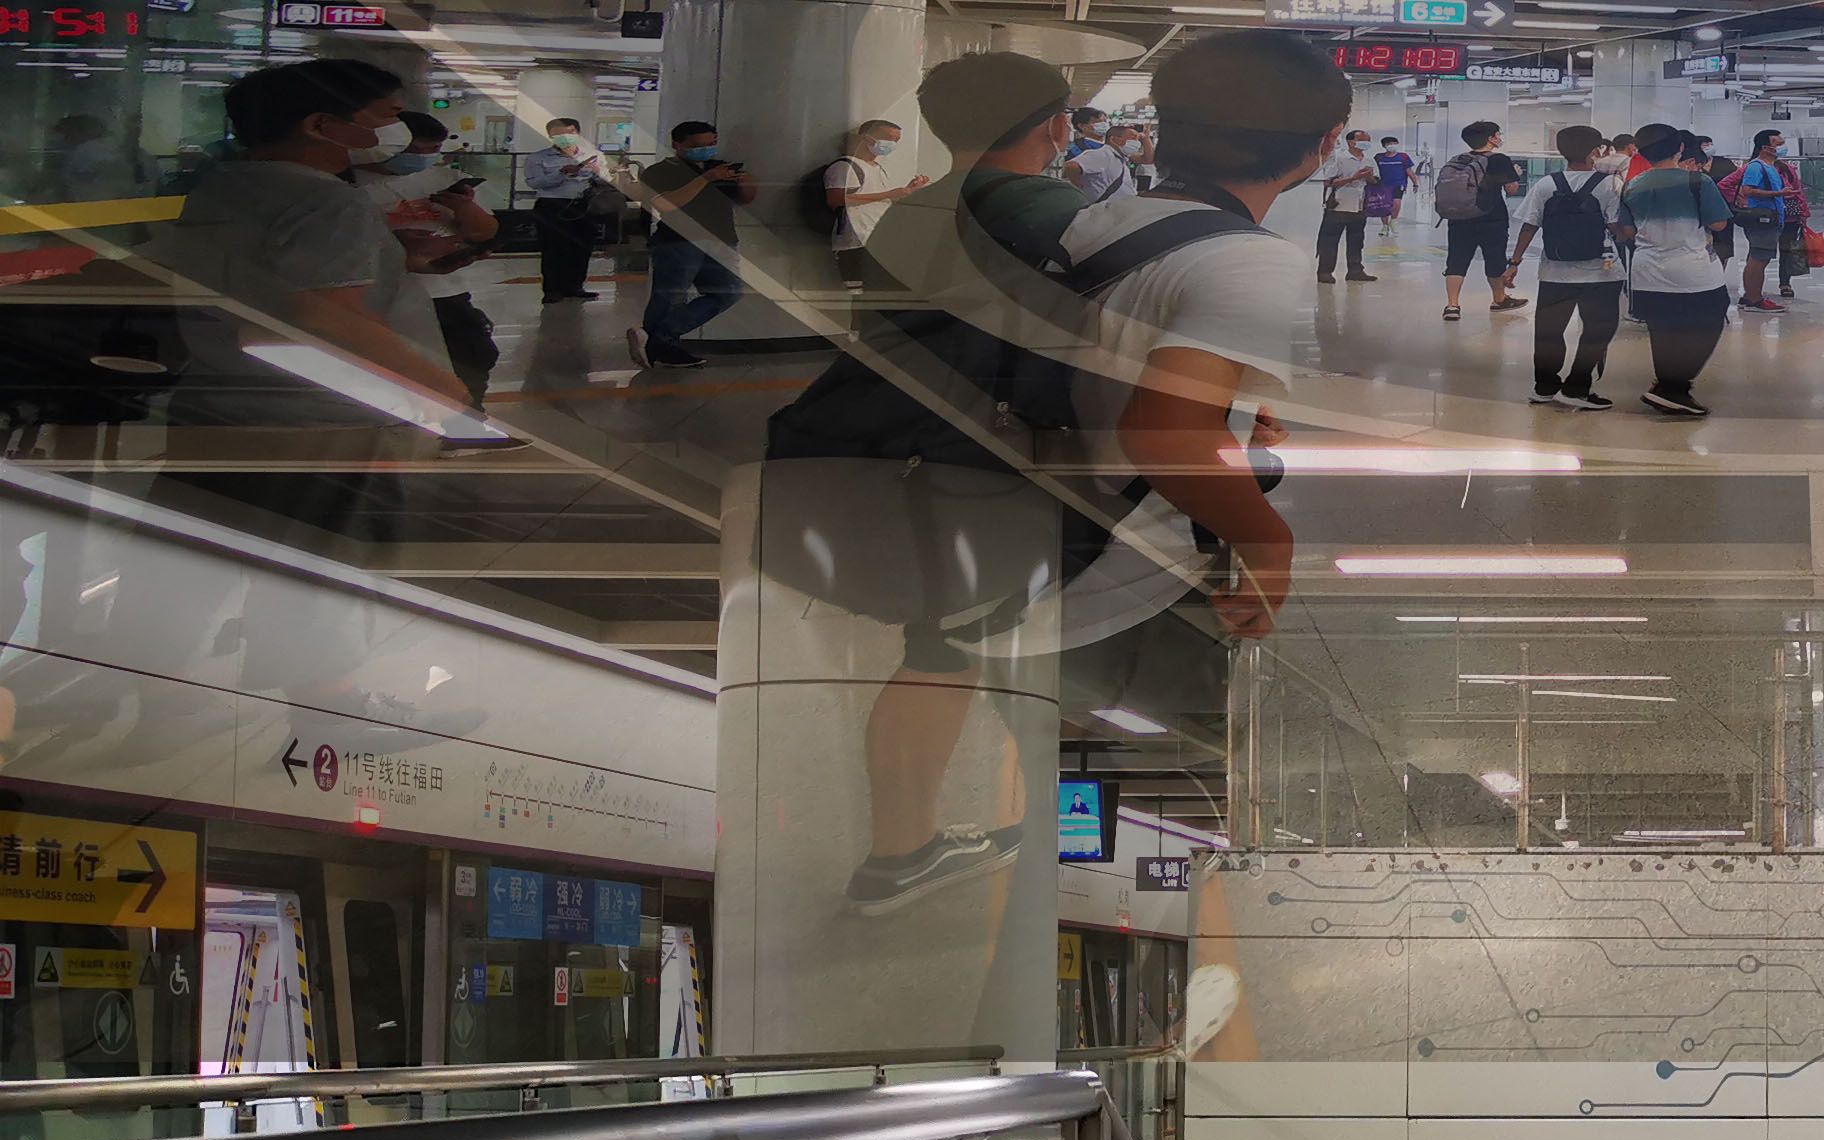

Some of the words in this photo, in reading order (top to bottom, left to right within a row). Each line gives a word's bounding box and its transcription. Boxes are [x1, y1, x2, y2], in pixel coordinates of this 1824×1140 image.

[1412, 2, 1428, 19] 6
[321, 749, 332, 775] 2
[344, 751, 443, 792] 11号线往福田
[343, 781, 363, 798] Line
[378, 789, 387, 801] to
[389, 789, 417, 806] Futian
[1148, 862, 1180, 878] 电梯
